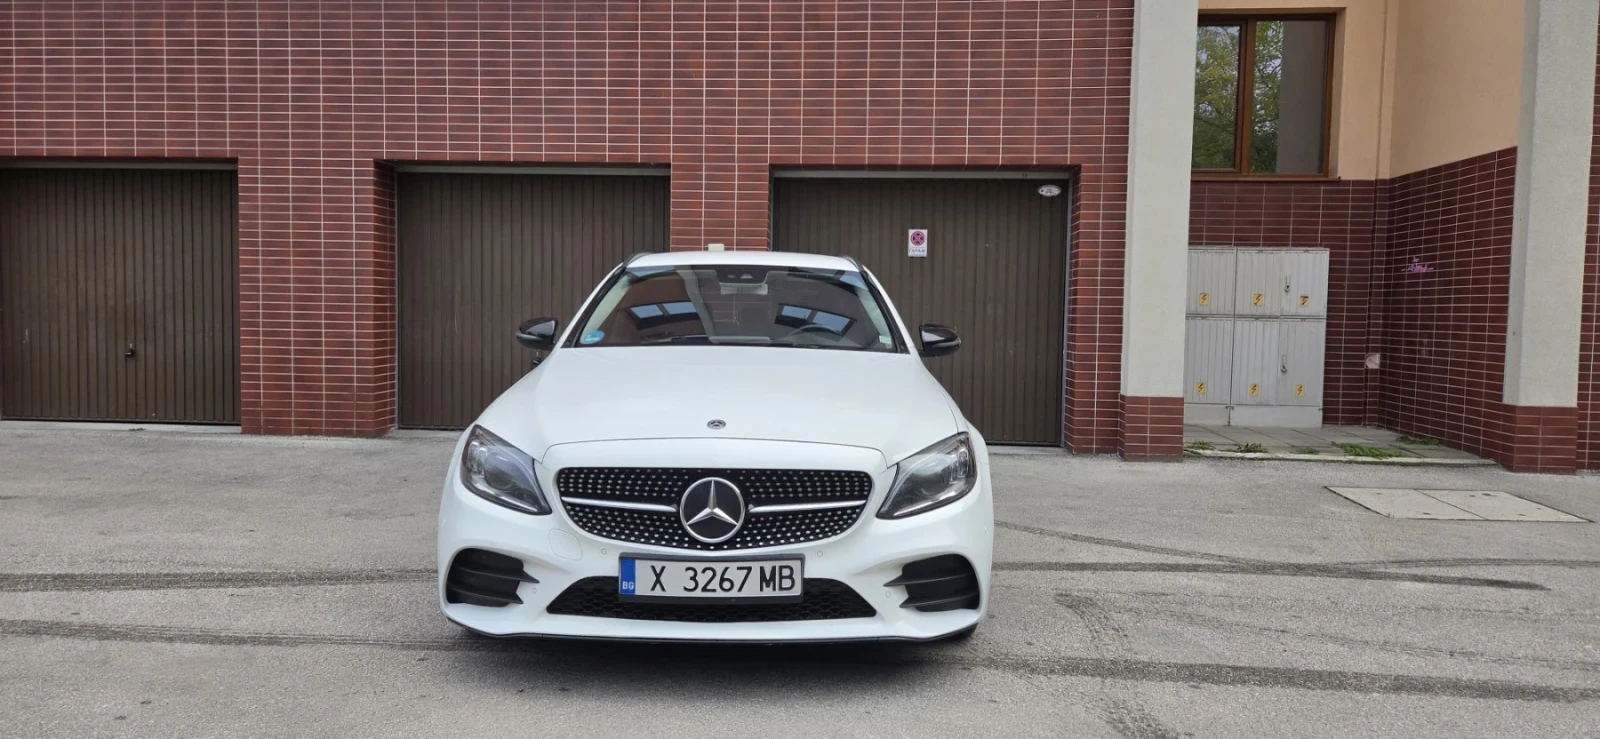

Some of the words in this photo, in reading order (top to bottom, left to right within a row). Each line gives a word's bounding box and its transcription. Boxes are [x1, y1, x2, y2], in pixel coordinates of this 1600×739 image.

[622, 581, 635, 590] BG
[650, 565, 667, 592] X
[683, 566, 753, 593] 3267
[759, 565, 796, 592] MB
